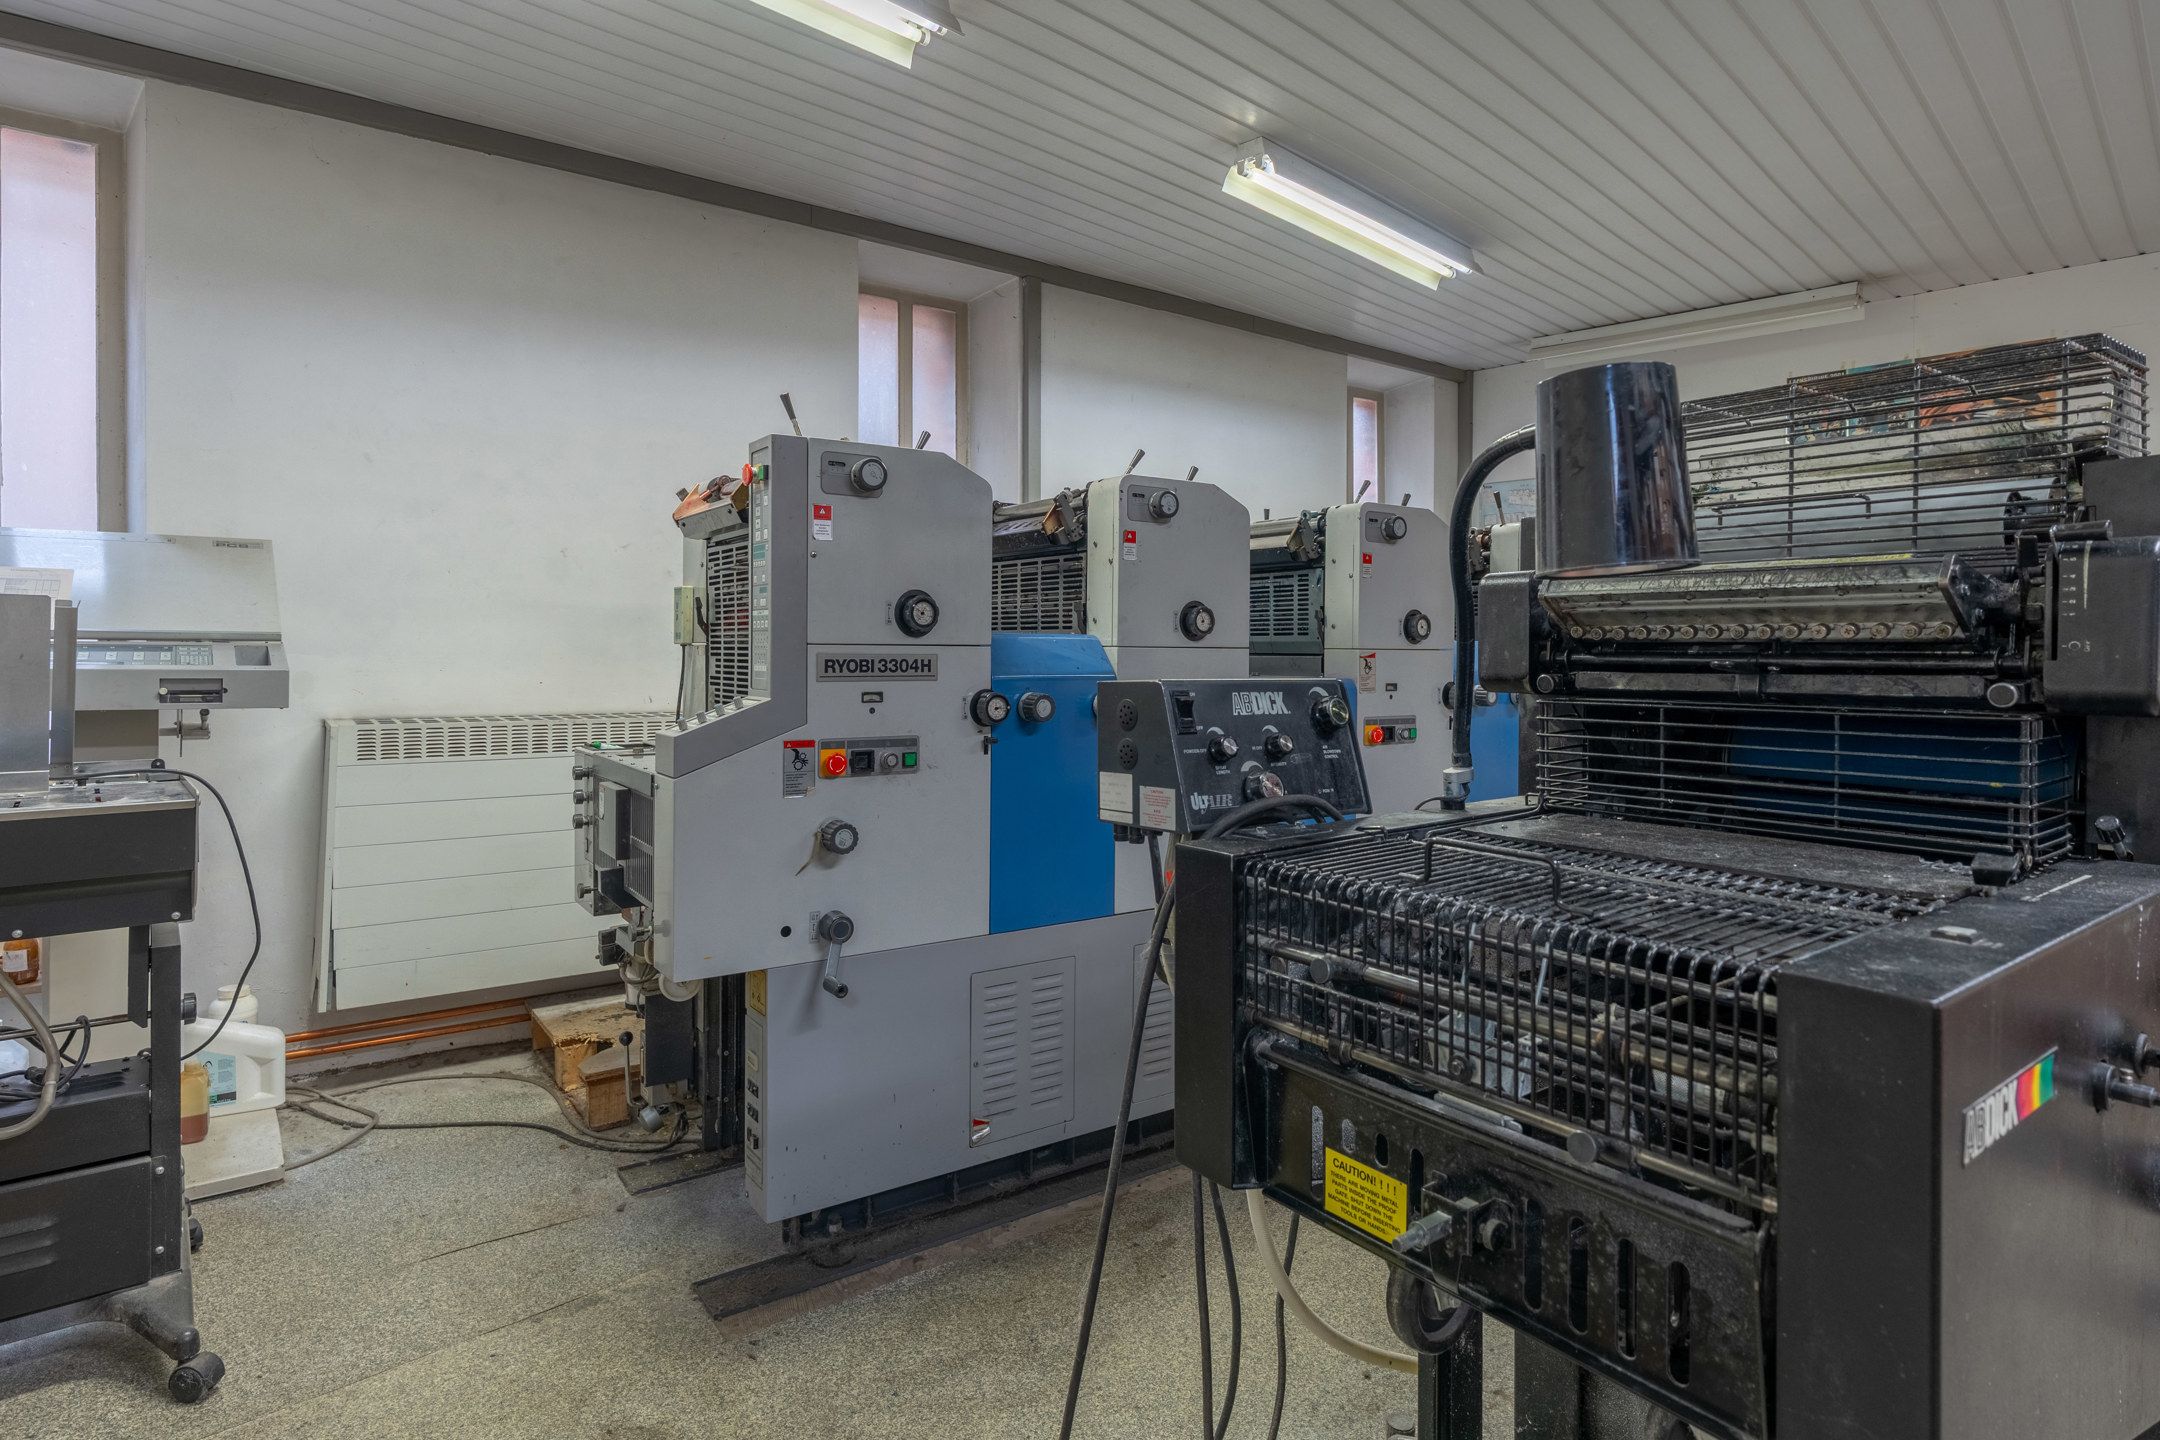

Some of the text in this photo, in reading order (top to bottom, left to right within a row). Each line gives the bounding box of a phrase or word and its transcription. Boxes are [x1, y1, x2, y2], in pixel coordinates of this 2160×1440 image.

[824, 658, 932, 674] RYOBI 3304H
[1330, 1170, 1399, 1207] THERE ARE MOVING METAL
[1331, 1179, 1397, 1215] PARTS INSIDE THE PROOF
[1327, 1192, 1401, 1233] MACHINE BEFORE INSERTING
[1340, 1207, 1358, 1220] TOOLS
[1358, 1215, 1367, 1225] OR
[1350, 1195, 1364, 1207] SHUT
[1365, 1203, 1382, 1216] DOWN
[1383, 1212, 1394, 1222] THE
